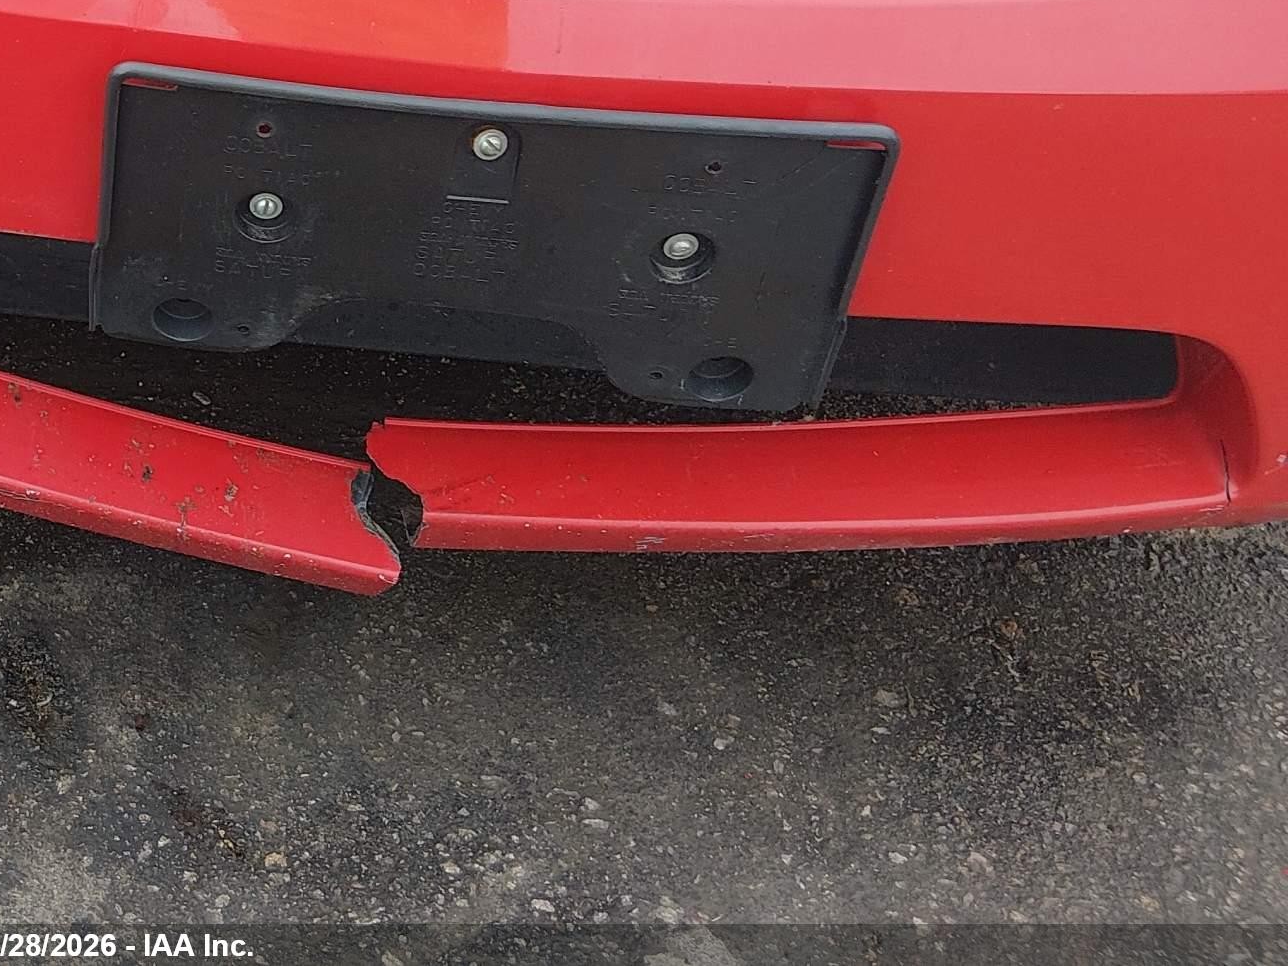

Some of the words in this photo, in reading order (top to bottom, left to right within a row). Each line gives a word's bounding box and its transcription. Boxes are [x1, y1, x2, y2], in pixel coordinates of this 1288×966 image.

[222, 134, 314, 162] COBALT
[223, 164, 311, 186] POTIAC
[442, 201, 505, 217] CHEY
